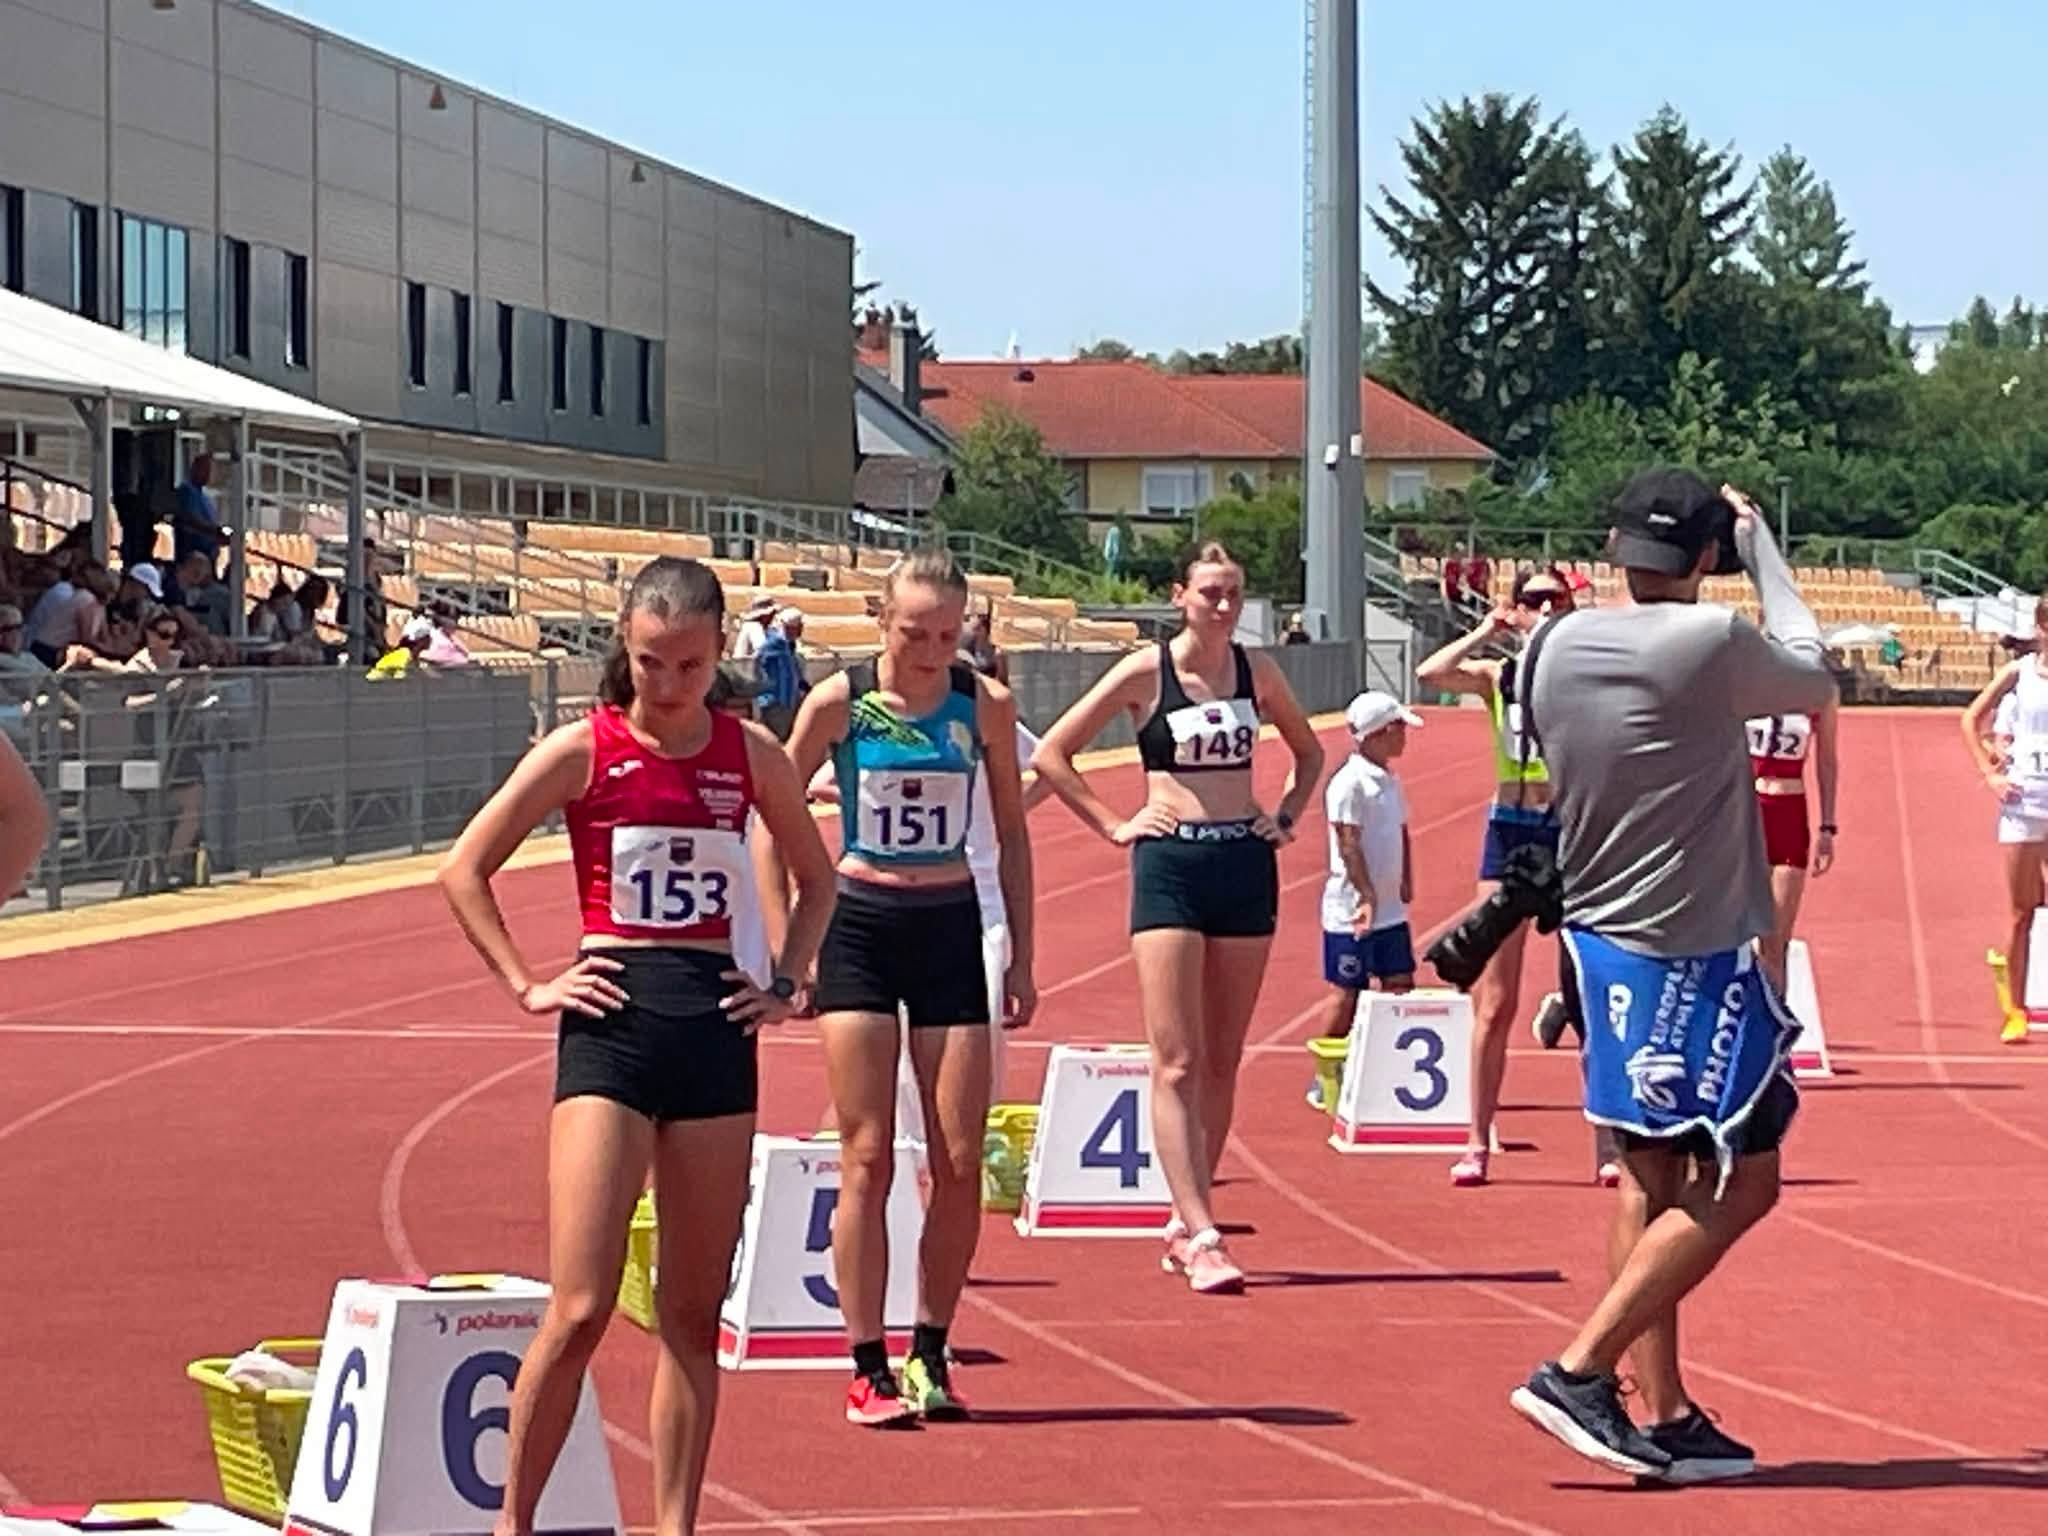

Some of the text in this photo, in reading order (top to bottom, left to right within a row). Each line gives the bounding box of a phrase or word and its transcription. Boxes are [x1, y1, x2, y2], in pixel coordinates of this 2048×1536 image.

[1187, 726, 1253, 762] 148
[873, 806, 949, 846] 151
[630, 869, 728, 922] 153
[1394, 1027, 1448, 1111] 3
[1697, 981, 1744, 1102] PHOTO
[1080, 1089, 1150, 1188] 4
[324, 1346, 367, 1503] 6
[442, 1350, 524, 1510] 6
